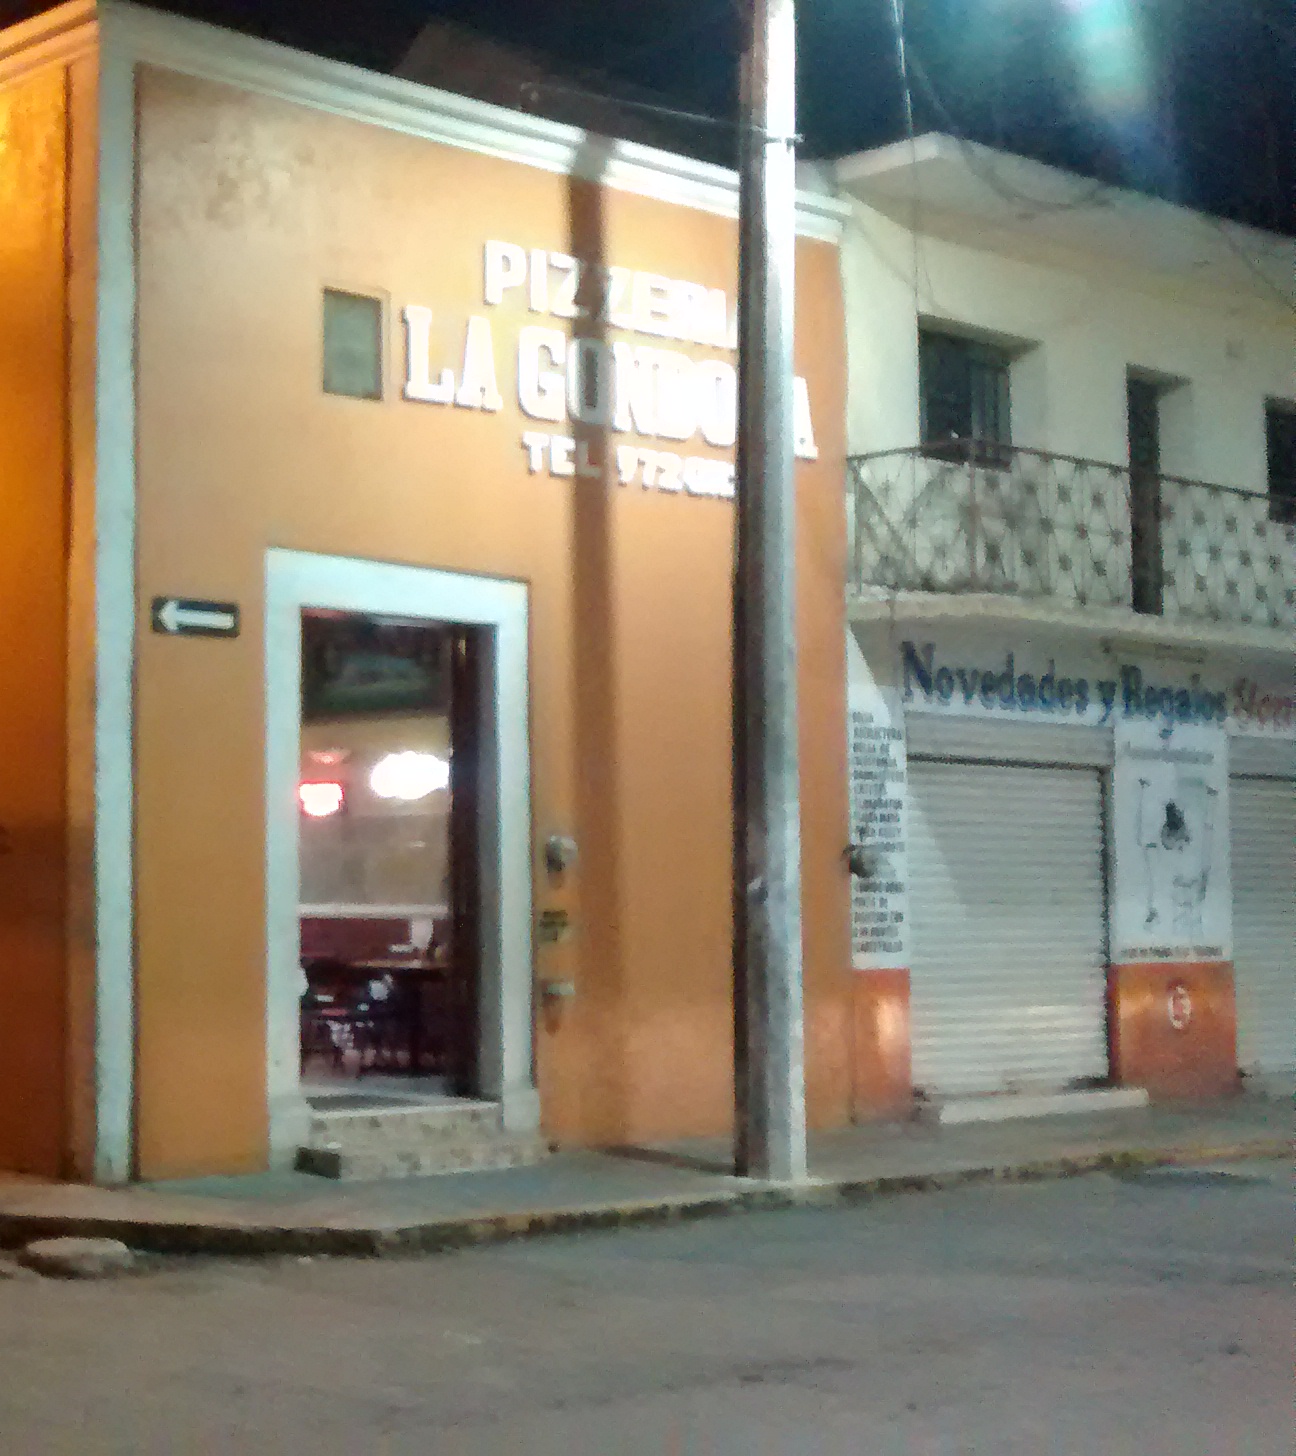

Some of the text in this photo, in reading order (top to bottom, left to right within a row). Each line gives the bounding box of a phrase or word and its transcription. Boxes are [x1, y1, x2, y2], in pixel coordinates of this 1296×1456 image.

[484, 239, 737, 350] PIZZERI
[403, 305, 819, 459] LA GONDOA
[901, 641, 1089, 712] Novedades
[1097, 679, 1117, 724] y
